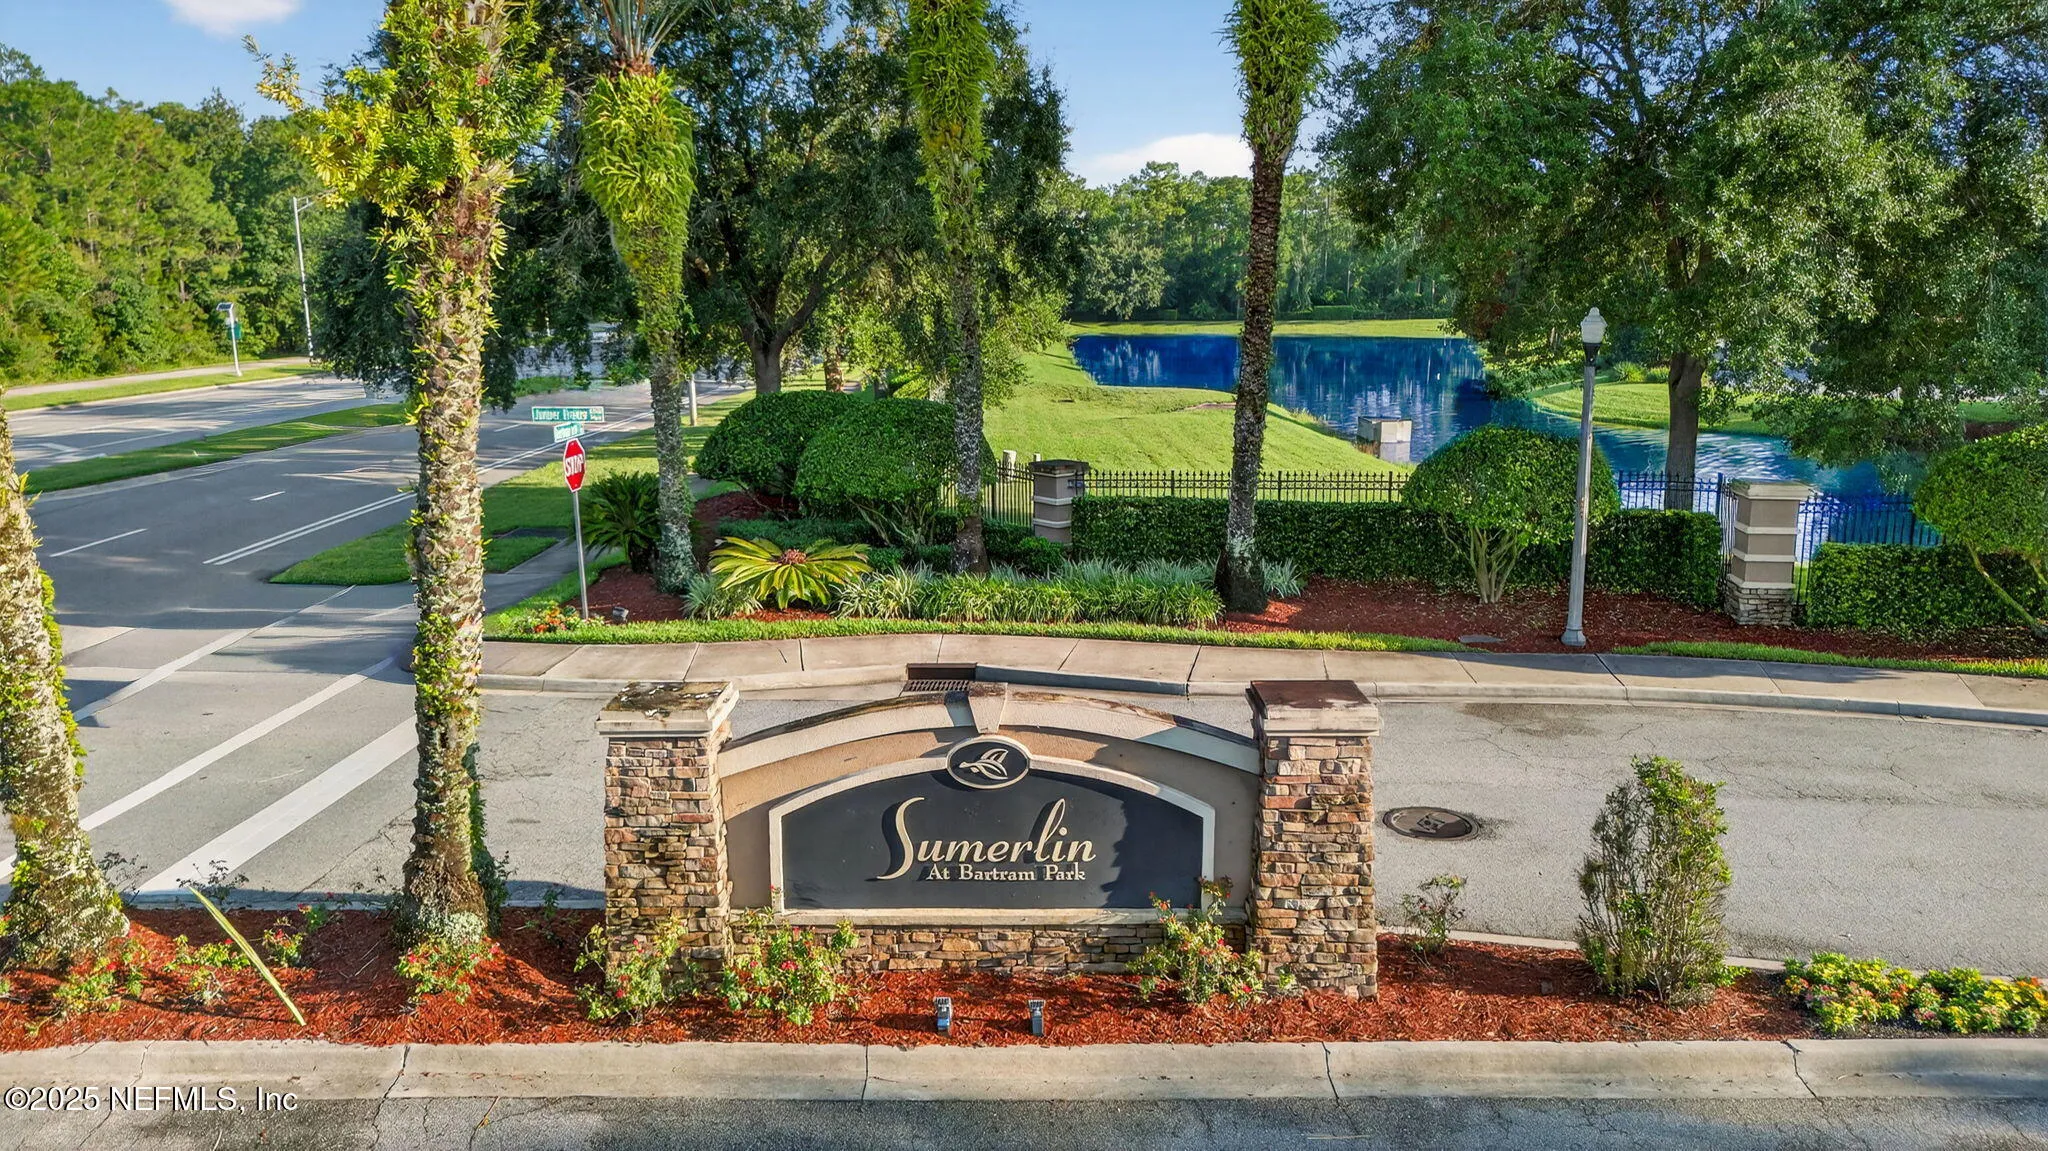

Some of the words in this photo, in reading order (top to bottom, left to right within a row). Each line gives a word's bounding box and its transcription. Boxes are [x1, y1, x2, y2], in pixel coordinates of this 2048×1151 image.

[566, 453, 584, 477] STOP
[877, 797, 1096, 880] Sumerlin
[926, 863, 950, 880] At
[959, 863, 1035, 881] Bartram
[1045, 862, 1086, 881] Park
